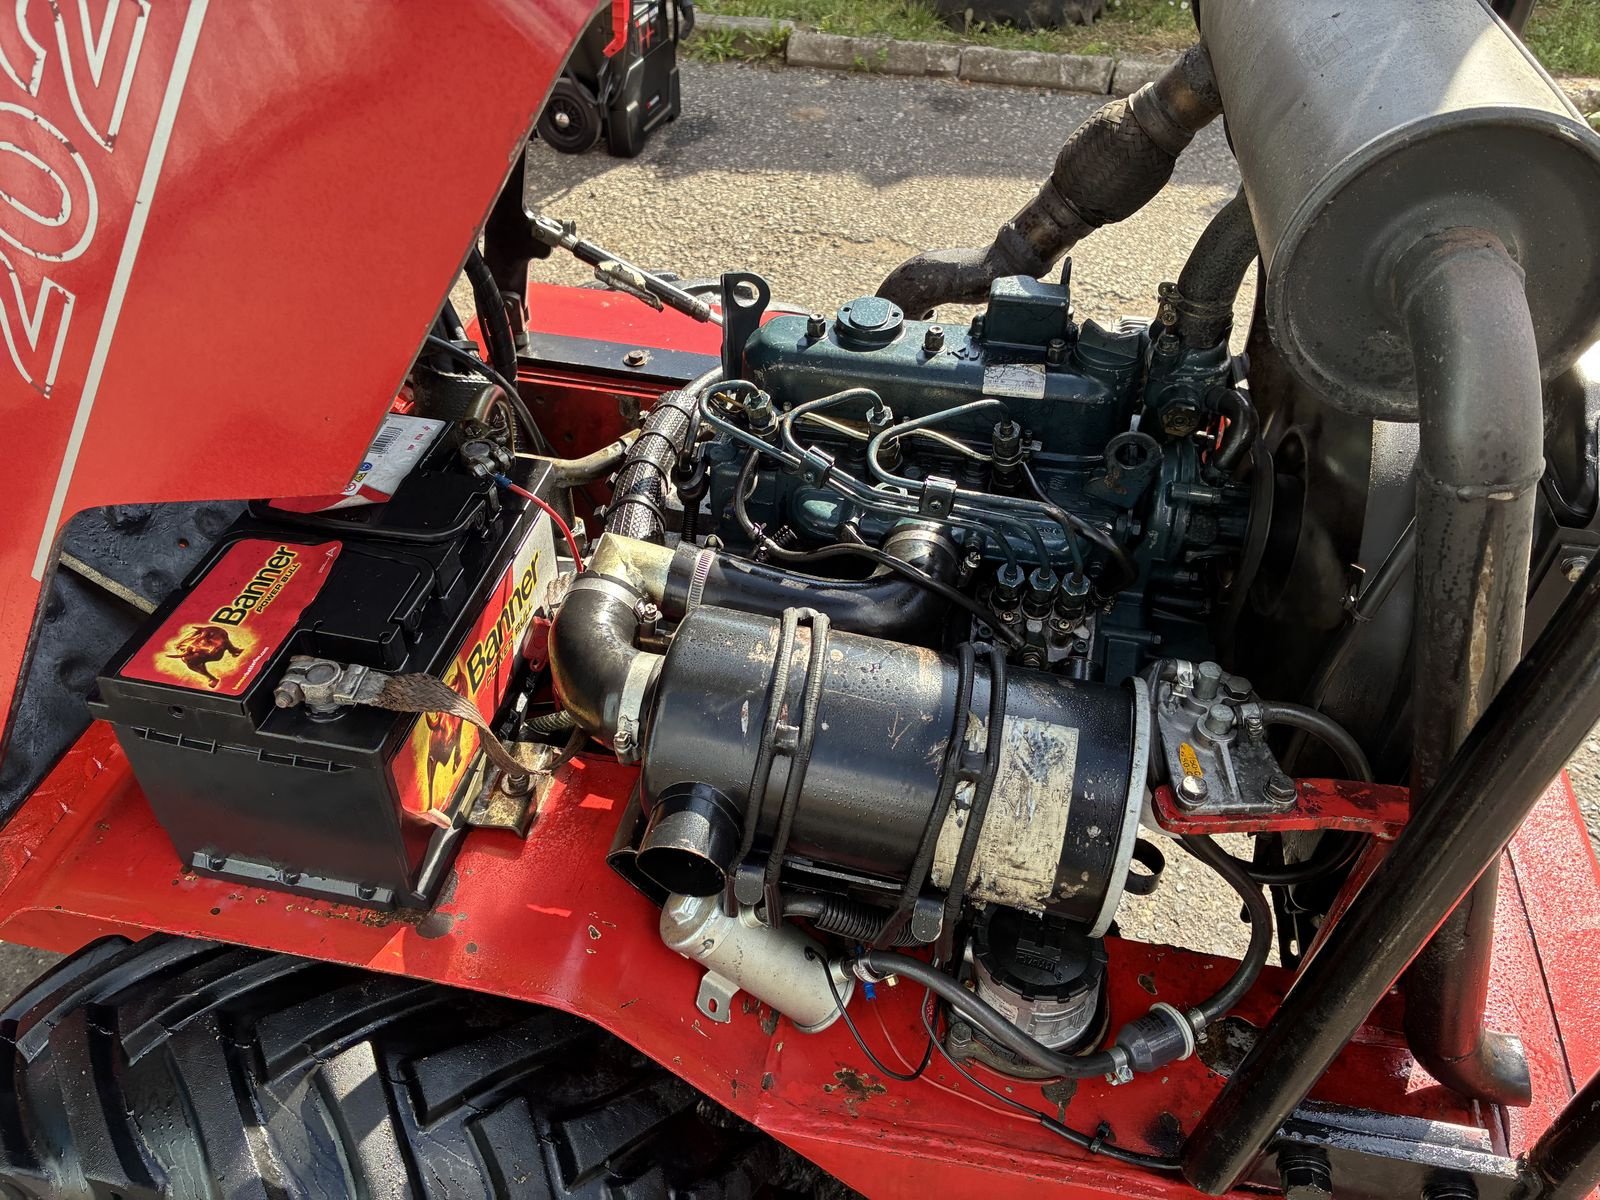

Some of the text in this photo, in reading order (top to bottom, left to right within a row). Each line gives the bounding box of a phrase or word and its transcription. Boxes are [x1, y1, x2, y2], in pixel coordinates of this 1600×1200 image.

[209, 545, 297, 626] Banner
[256, 562, 301, 613] POWER BULL
[466, 551, 540, 695] Banner
[486, 635, 514, 687] POWER
